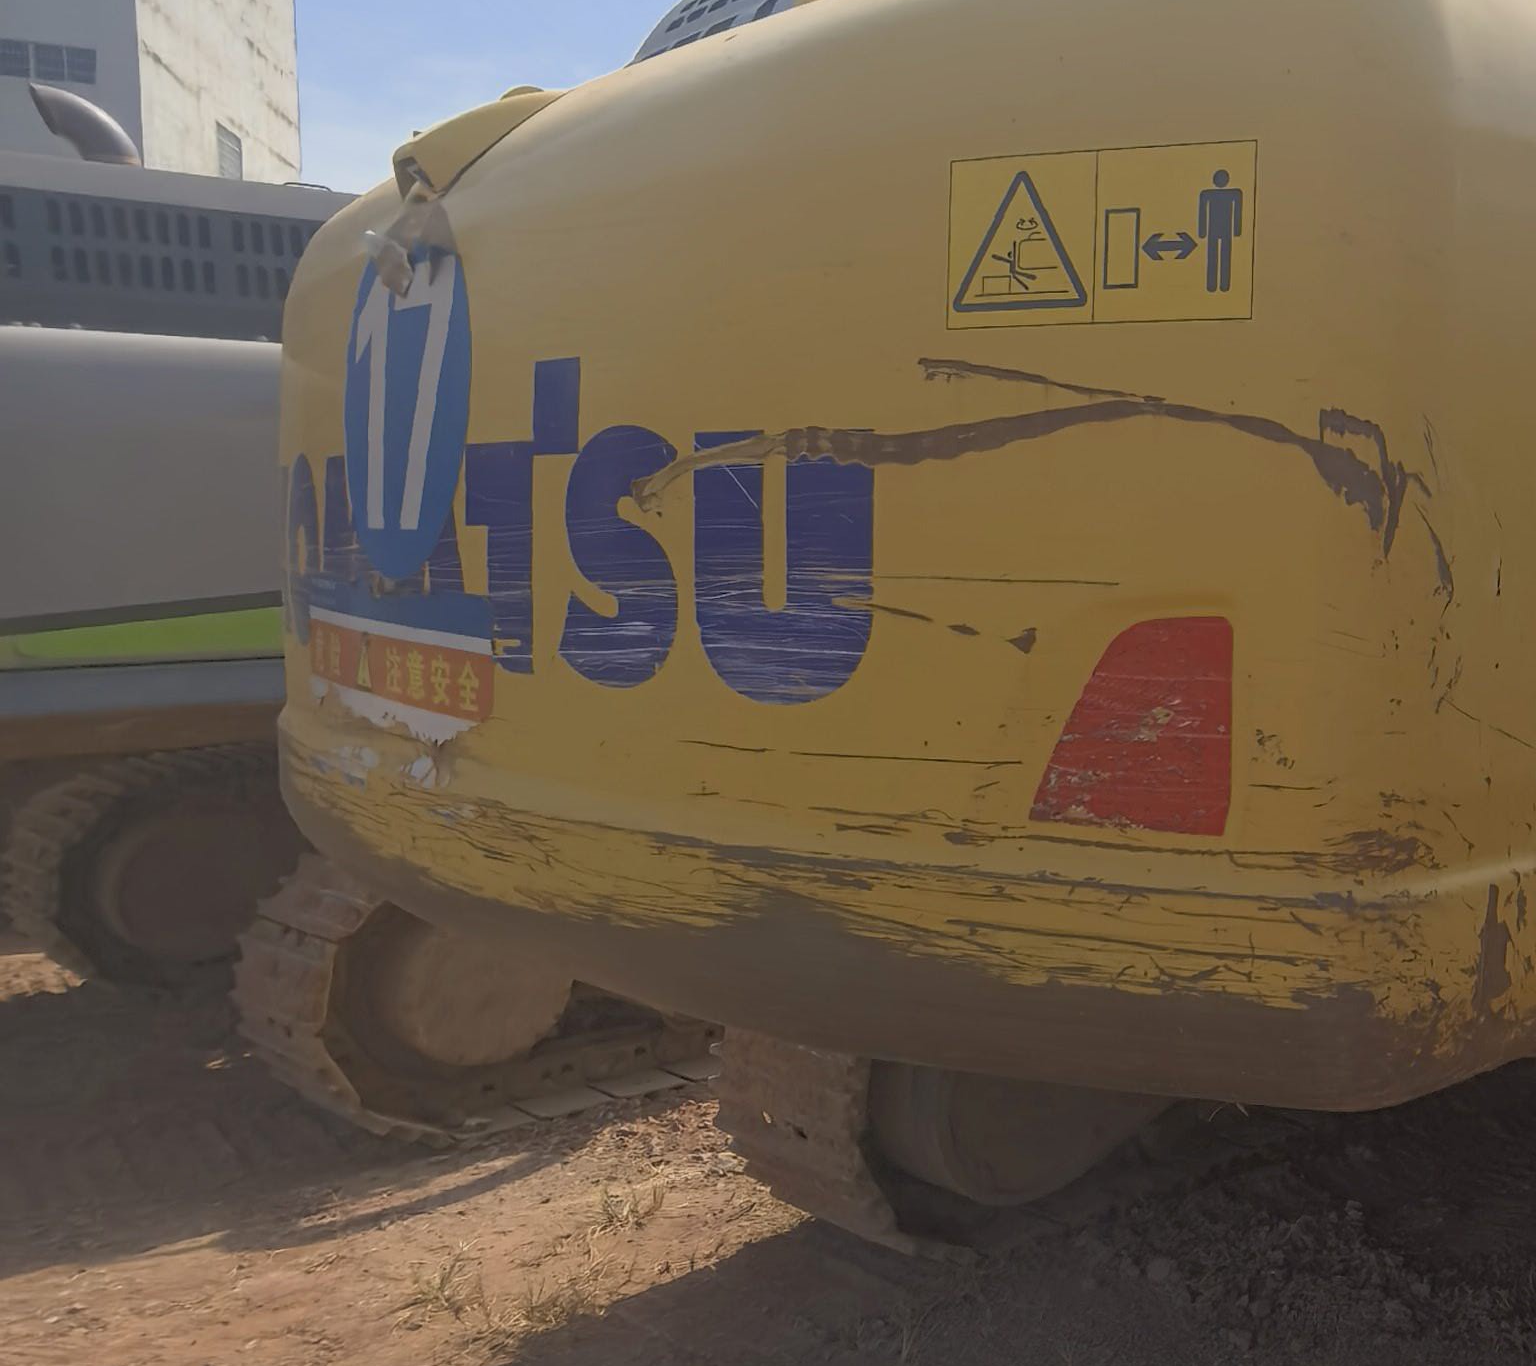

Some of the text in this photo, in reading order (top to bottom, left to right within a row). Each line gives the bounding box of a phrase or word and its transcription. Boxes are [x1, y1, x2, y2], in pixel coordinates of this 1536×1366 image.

[355, 254, 457, 530] 17
[385, 644, 480, 712] 注意安全
